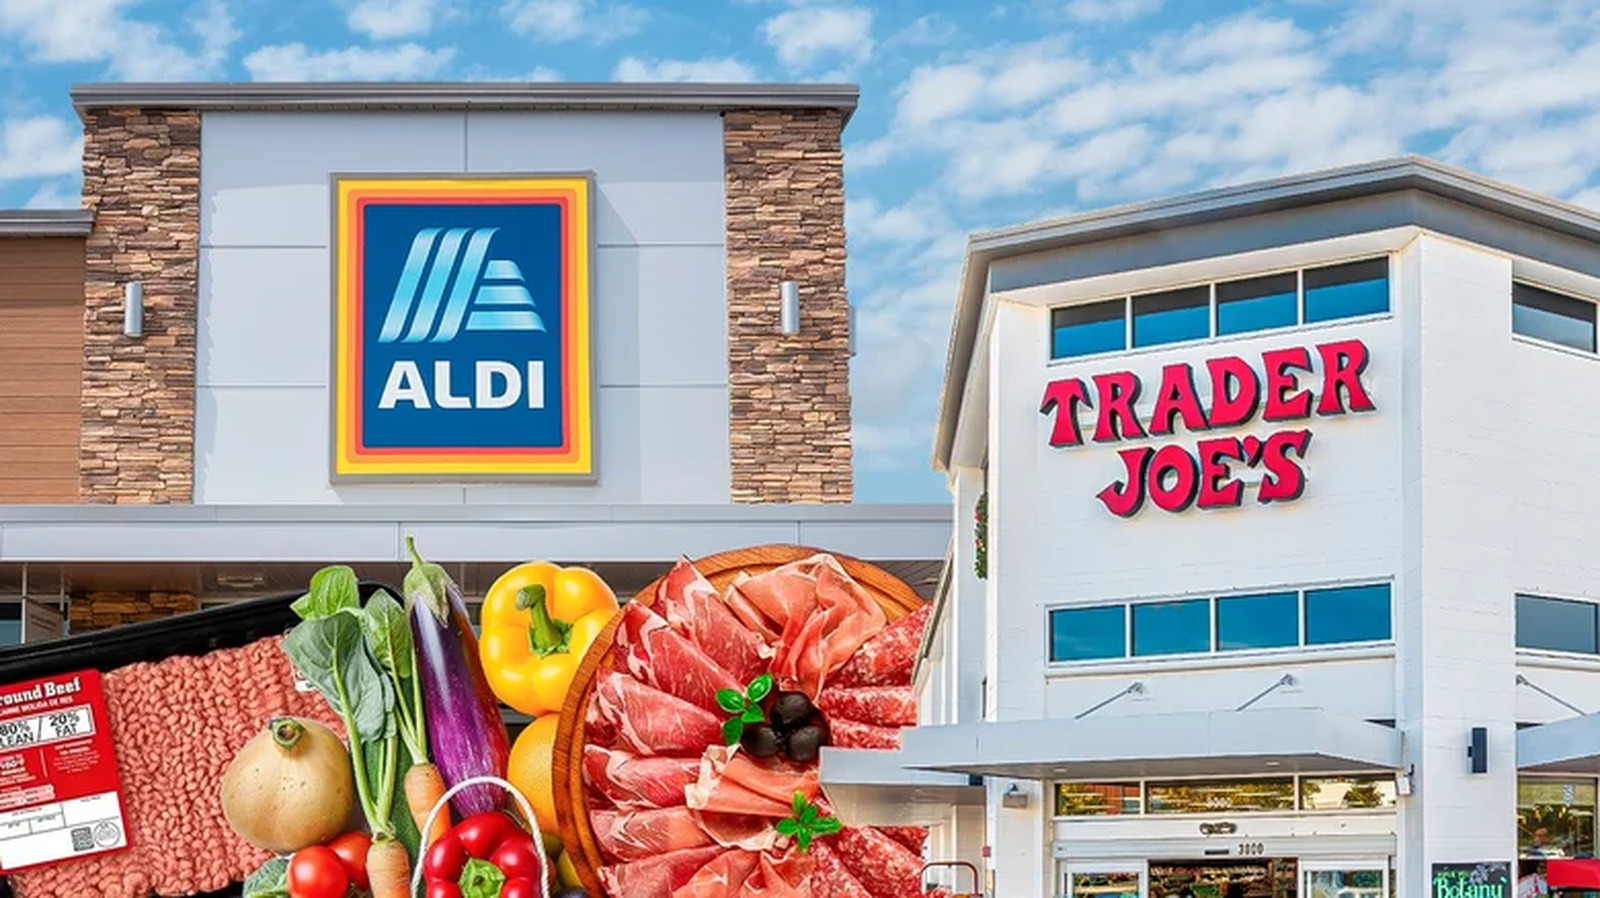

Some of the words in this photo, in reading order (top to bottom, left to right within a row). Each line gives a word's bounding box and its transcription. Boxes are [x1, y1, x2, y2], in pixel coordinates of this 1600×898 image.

[378, 360, 545, 409] ALDI
[1039, 339, 1376, 447] TRADER
[1096, 428, 1313, 518] JOE'S
[44, 676, 80, 698] Beef
[0, 720, 31, 737] 80%
[49, 710, 80, 727] 20%
[55, 722, 77, 737] FAT
